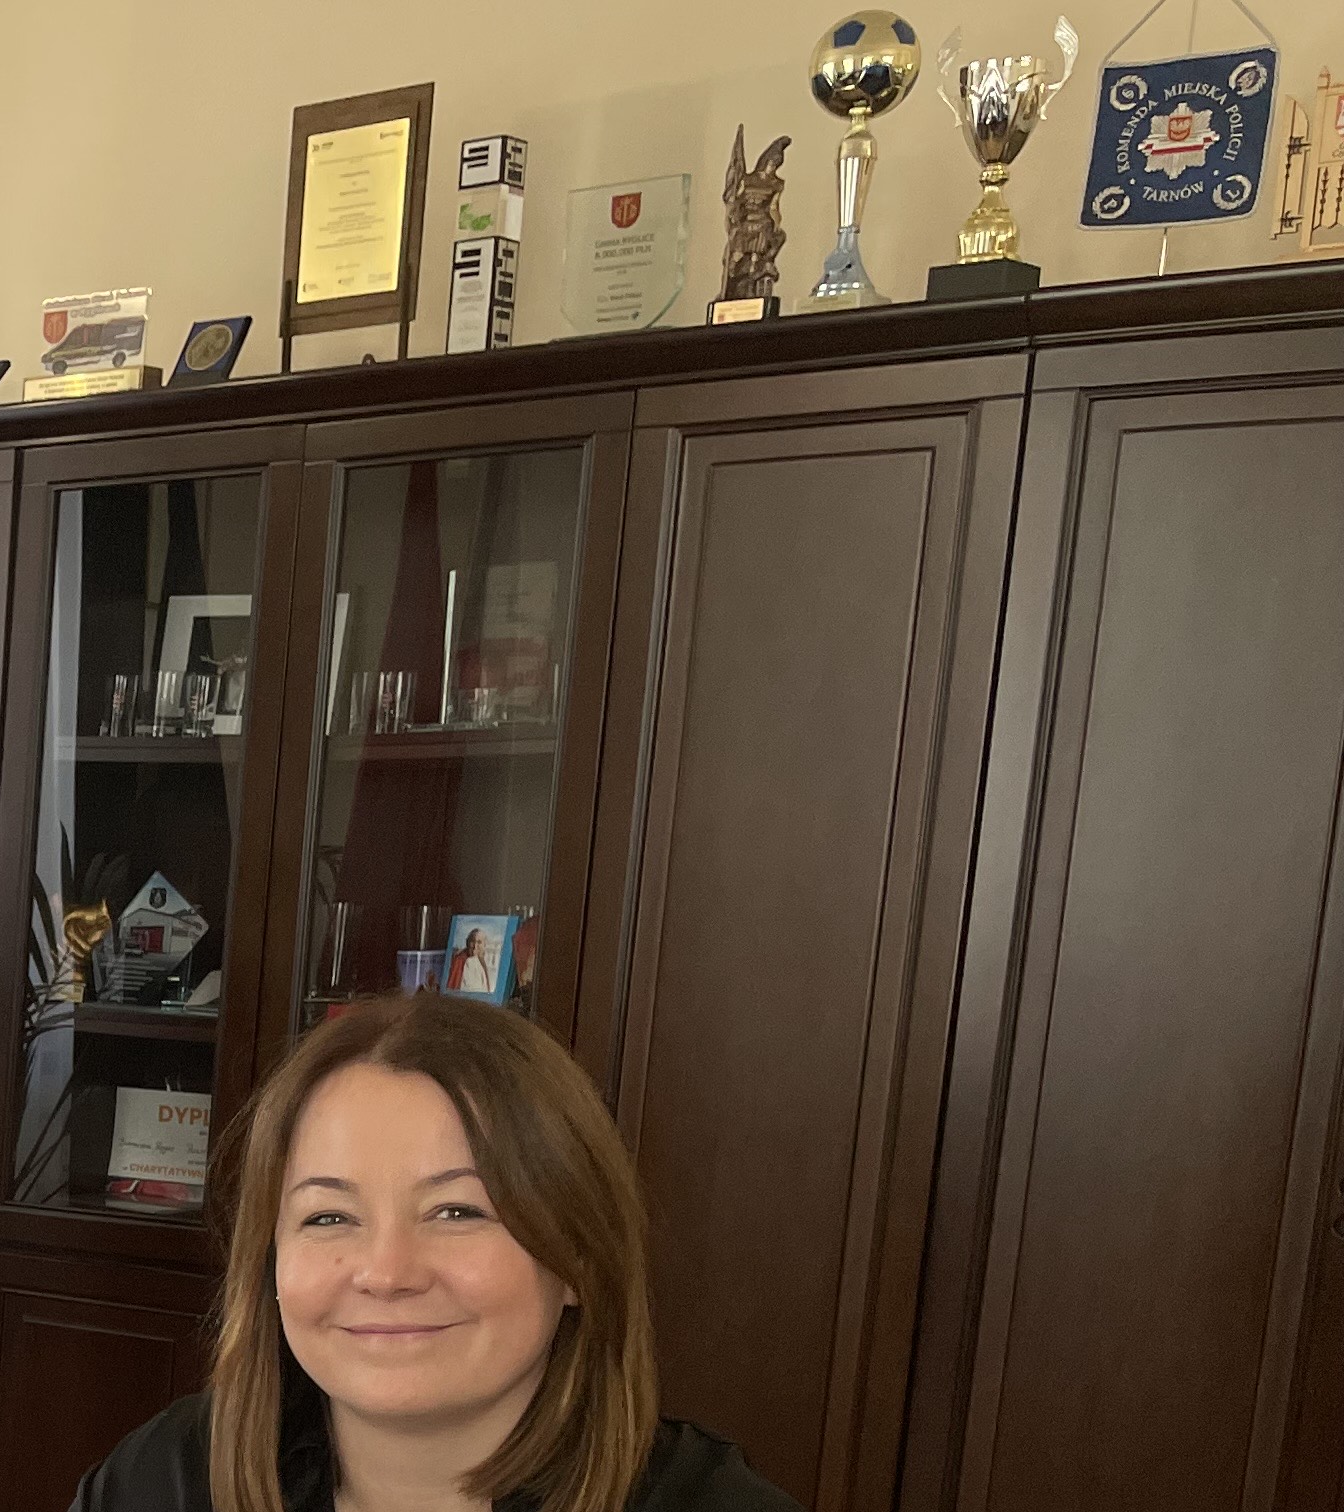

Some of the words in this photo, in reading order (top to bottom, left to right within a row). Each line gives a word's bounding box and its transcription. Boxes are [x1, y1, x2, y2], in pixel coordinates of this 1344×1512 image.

[1116, 99, 1159, 174] KOMENDA
[1164, 82, 1228, 106] MIEJSKA
[1142, 180, 1205, 203] TARNÓW
